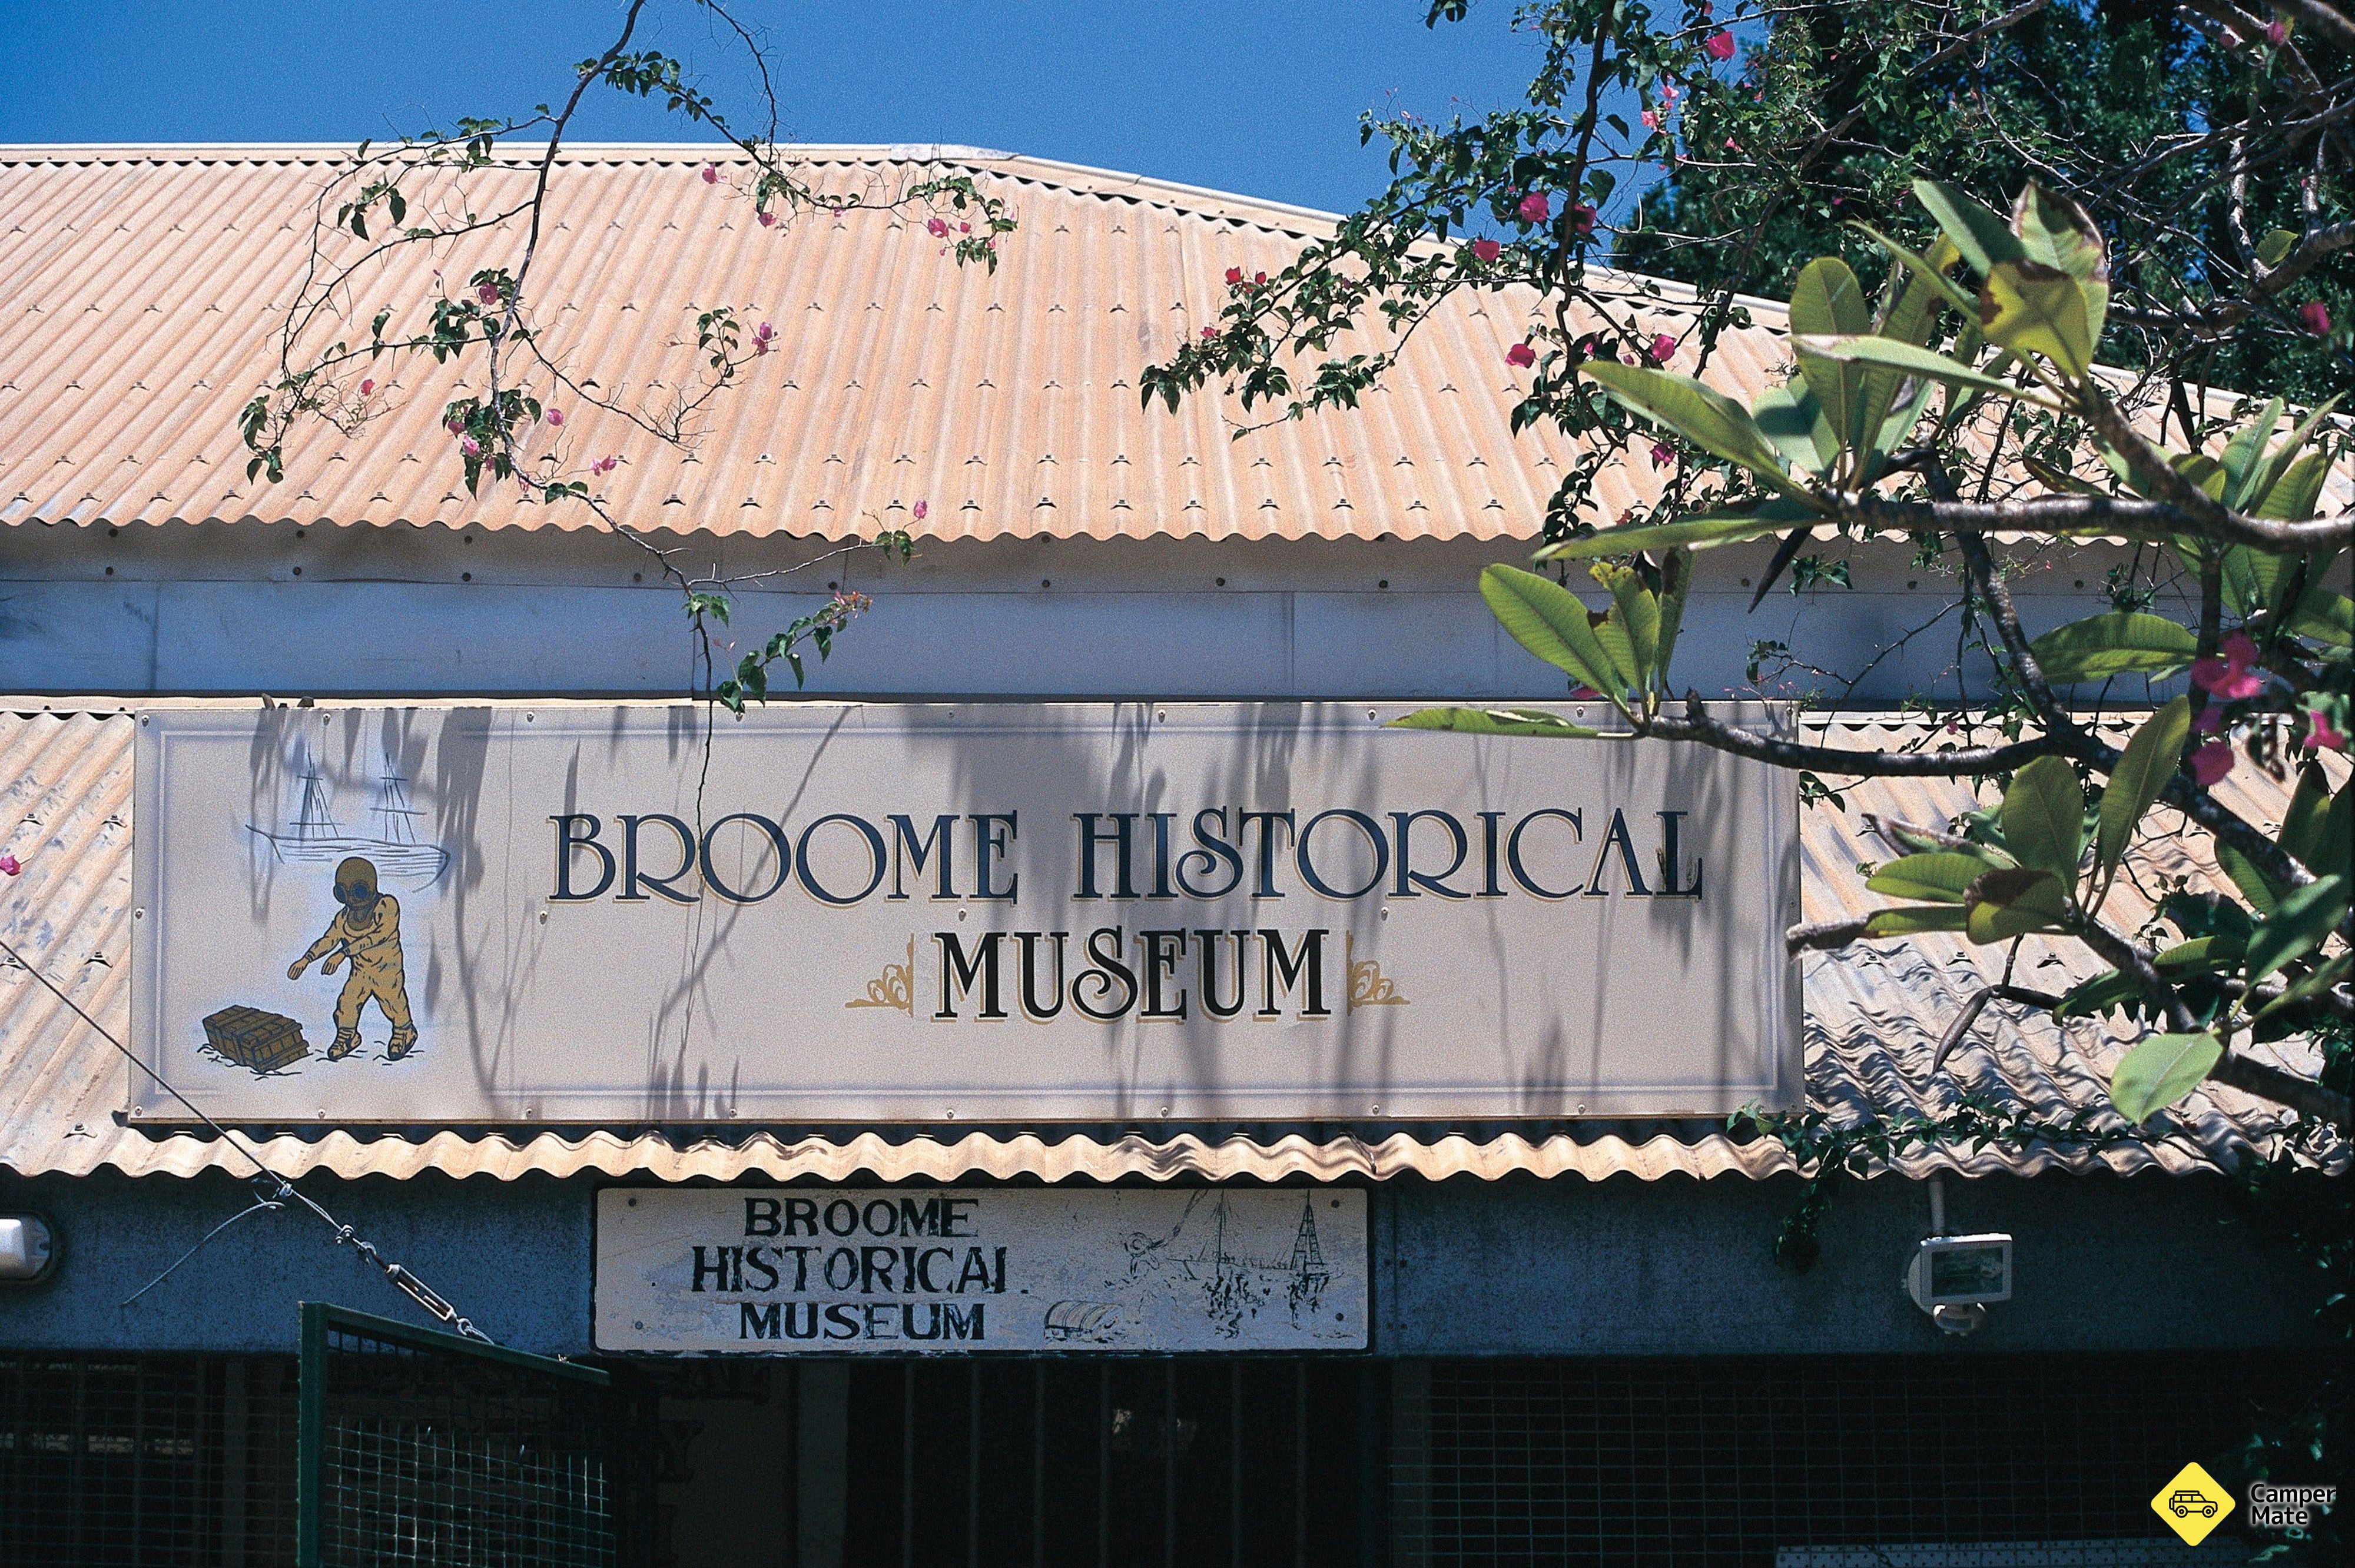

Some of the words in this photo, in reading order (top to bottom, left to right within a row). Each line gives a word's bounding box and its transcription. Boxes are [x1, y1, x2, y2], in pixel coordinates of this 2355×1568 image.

[546, 809, 1019, 908] BROOME
[1070, 805, 1704, 903] HISTORICAL
[930, 925, 1332, 1025] MUSEUM
[744, 1197, 979, 1237] BROOME
[739, 1303, 986, 1341] MUSEUM
